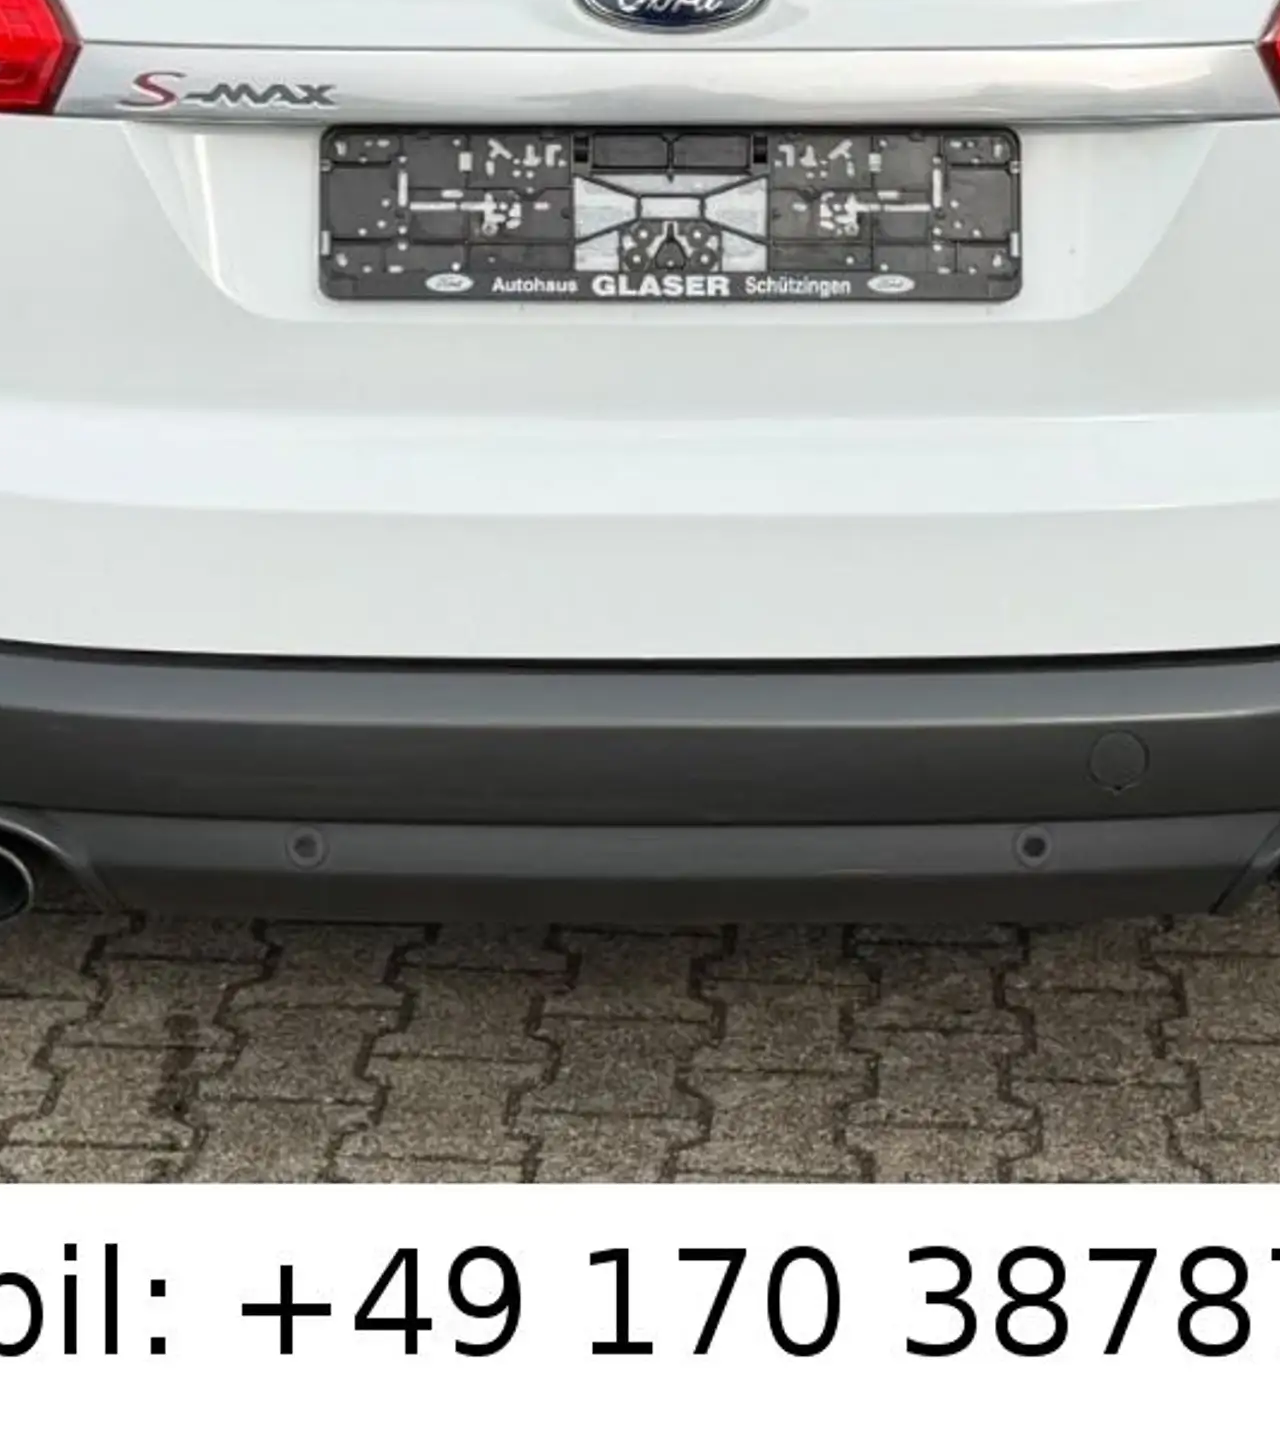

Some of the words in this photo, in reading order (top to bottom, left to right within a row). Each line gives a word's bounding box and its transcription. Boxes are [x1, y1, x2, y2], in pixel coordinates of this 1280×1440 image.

[116, 70, 337, 109] S-MAX
[491, 276, 578, 293] Autohaus
[591, 274, 731, 297] GLASER
[744, 275, 852, 298] Schützingen
